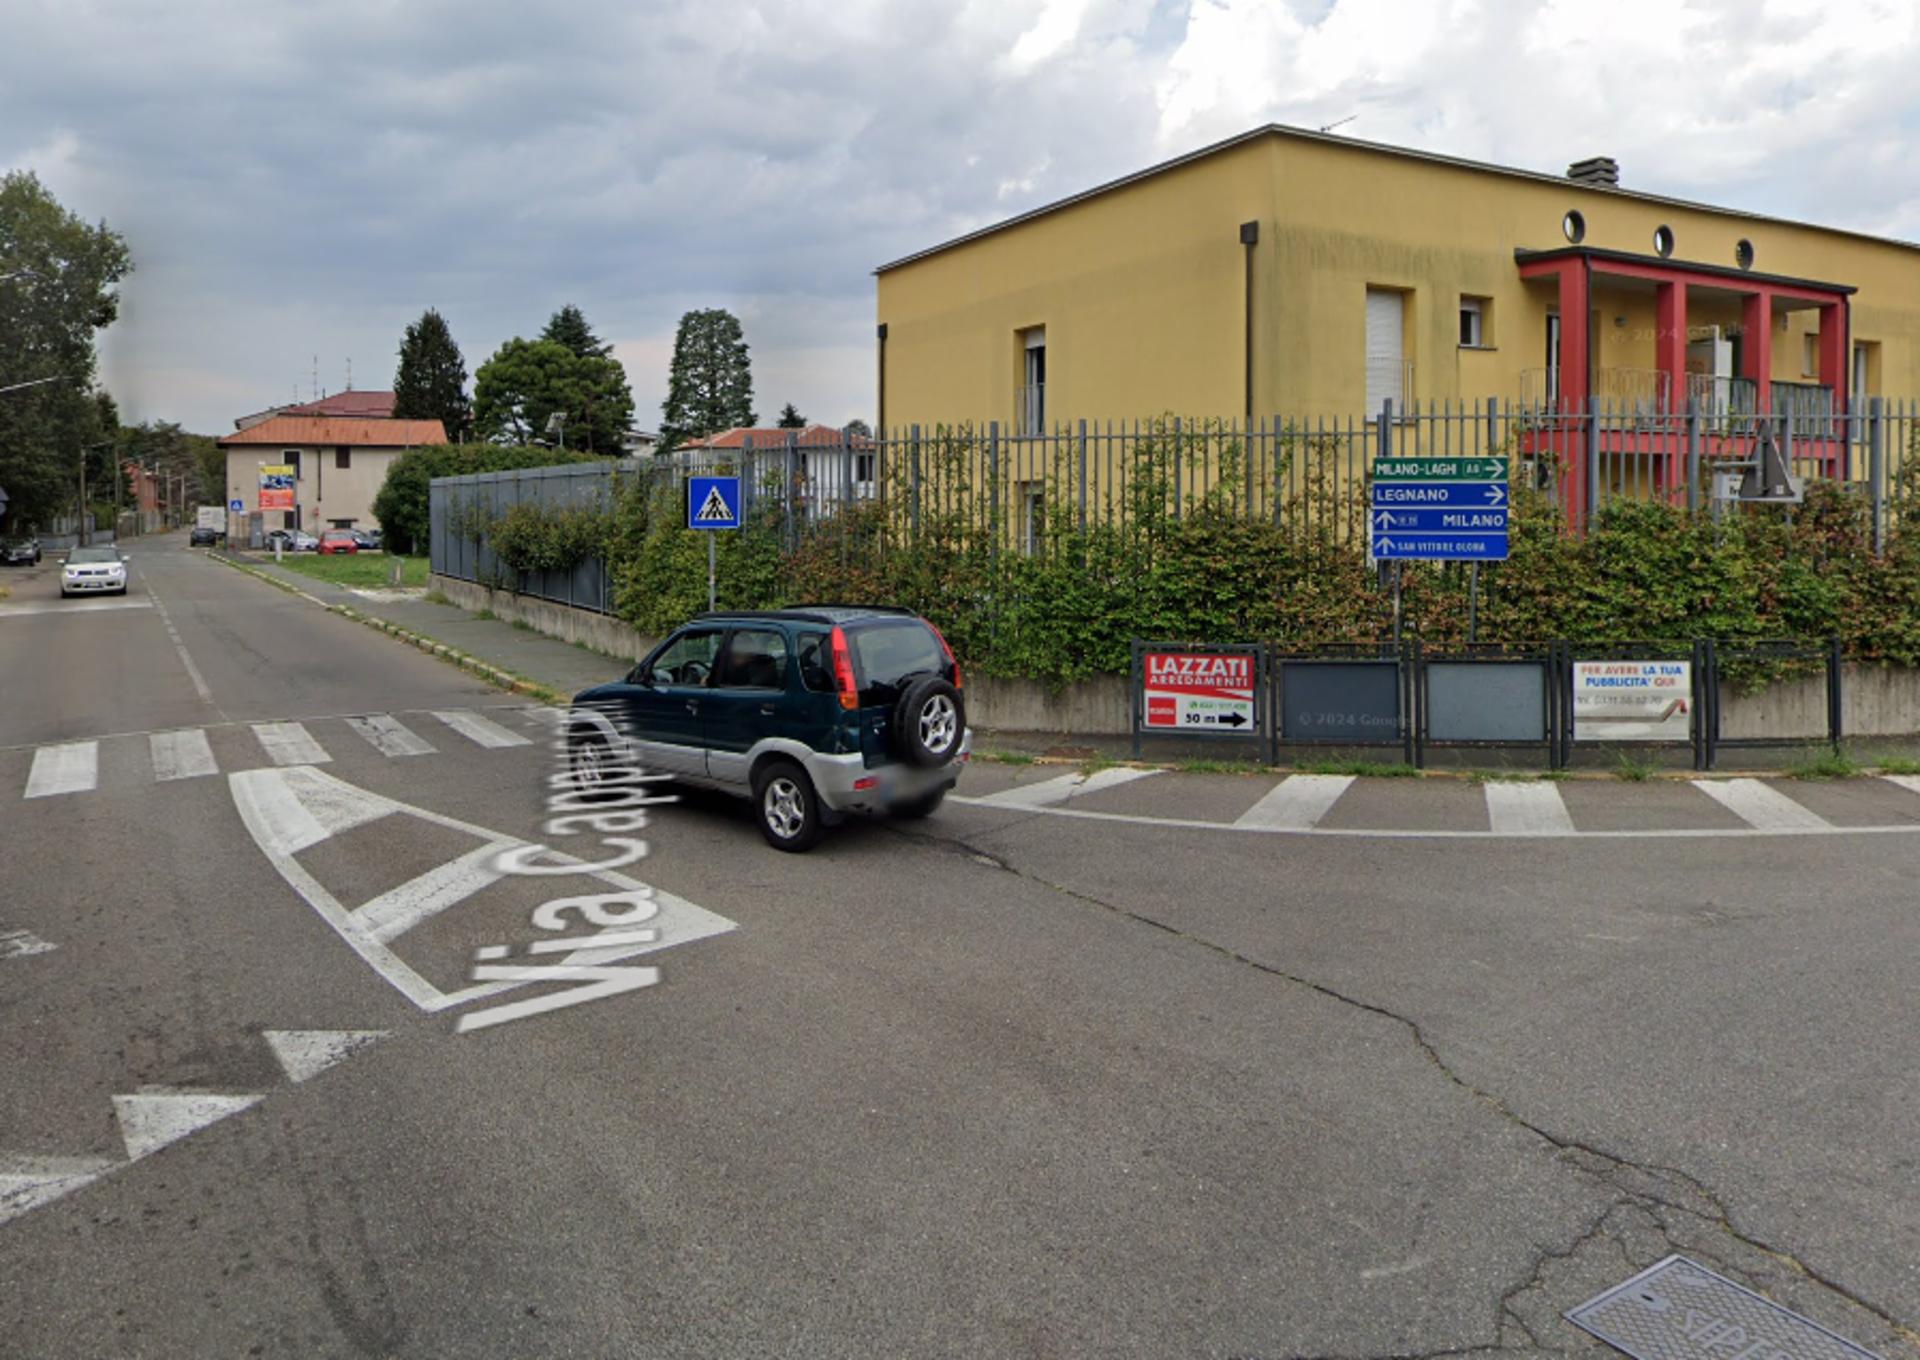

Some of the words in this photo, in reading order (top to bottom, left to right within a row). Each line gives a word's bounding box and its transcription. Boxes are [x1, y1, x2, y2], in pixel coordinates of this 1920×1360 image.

[1376, 489, 1449, 501] LEGNANO
[1442, 515, 1504, 527] MILANO
[1150, 656, 1248, 677] LAZZATI
[1581, 666, 1602, 674] PER
[1604, 666, 1639, 674] AVERE
[1642, 666, 1656, 675] LA
[1660, 666, 1682, 675] TUA
[1150, 675, 1248, 687] ARREDAMENTI
